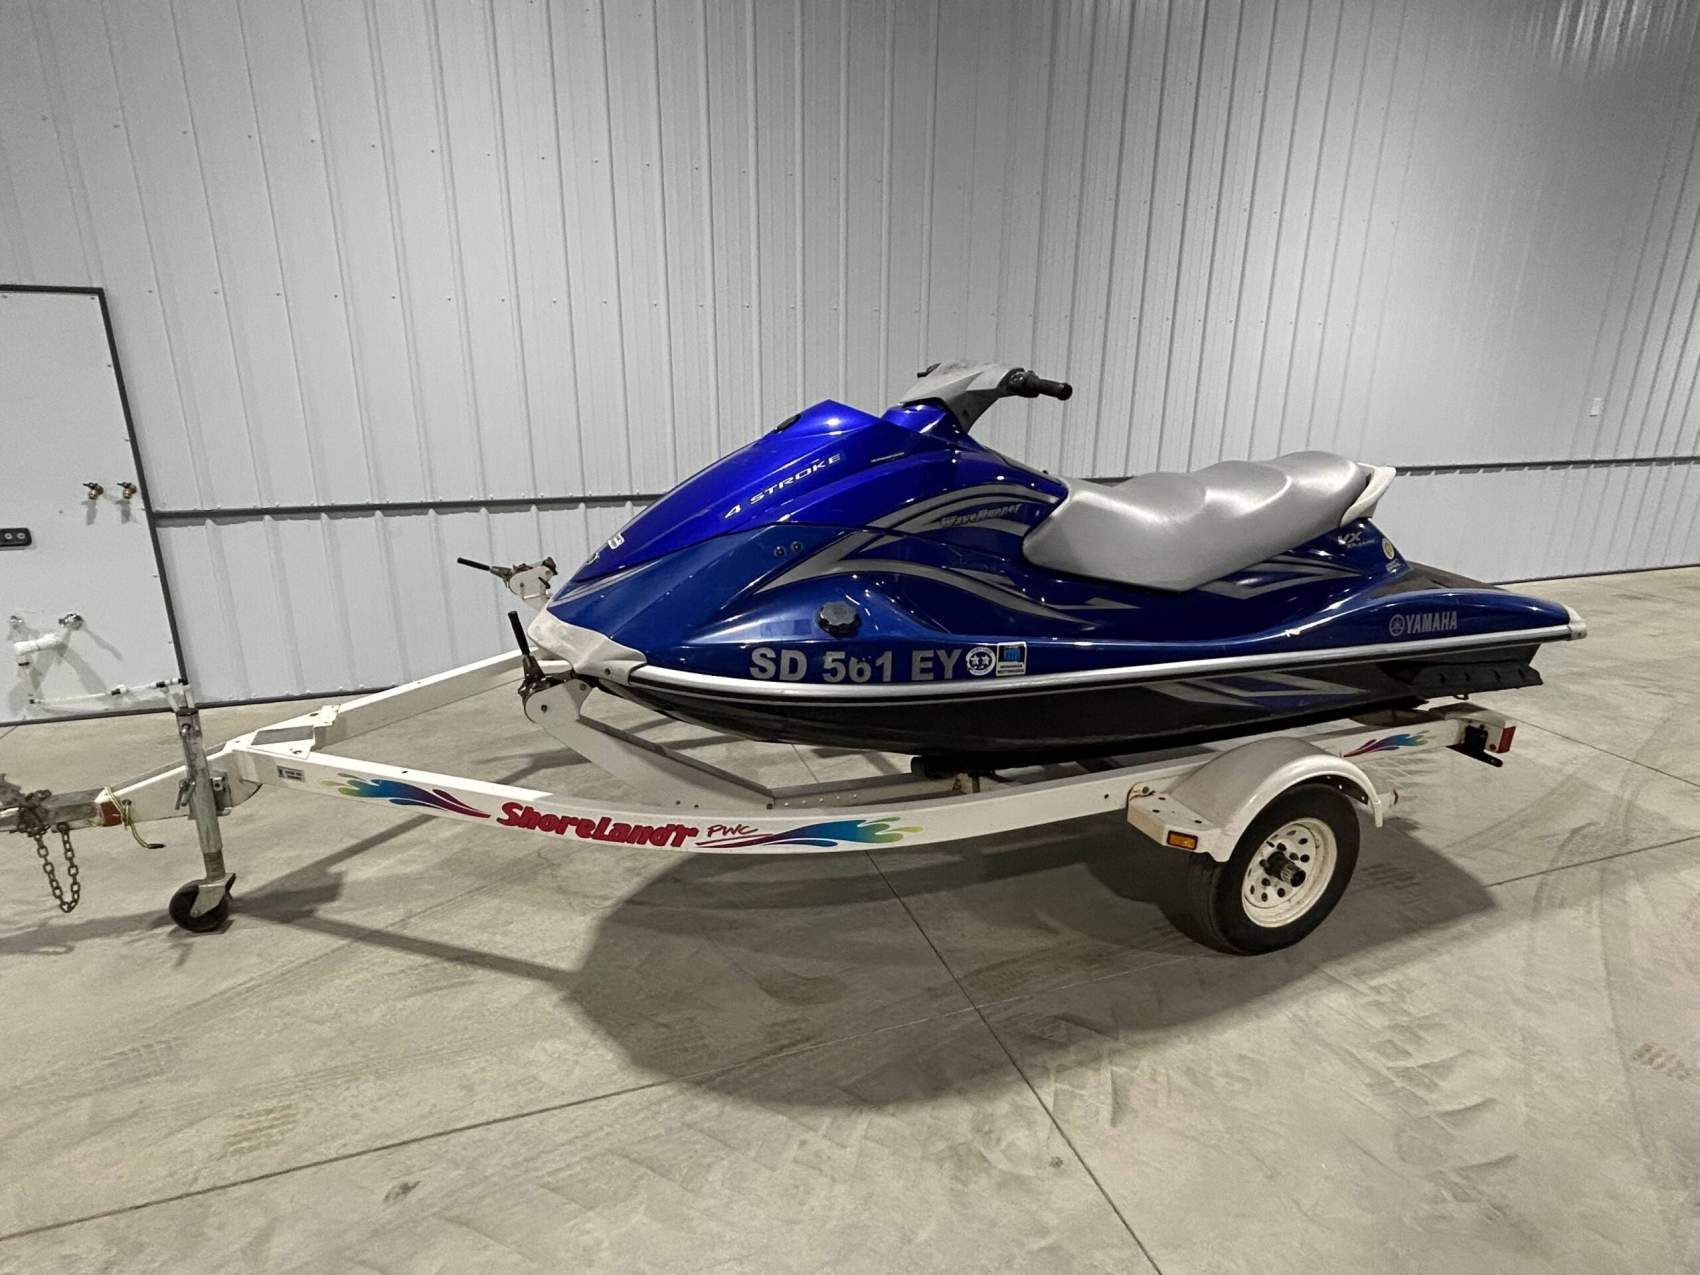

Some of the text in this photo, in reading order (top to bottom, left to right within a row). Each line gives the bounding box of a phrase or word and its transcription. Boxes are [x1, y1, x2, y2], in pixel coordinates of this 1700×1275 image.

[725, 453, 841, 519] 4 STROKE
[1405, 611, 1457, 634] YAMAHA
[750, 647, 808, 680] SD
[823, 651, 893, 683] 561
[911, 649, 962, 681] EY
[707, 814, 758, 838] PWC
